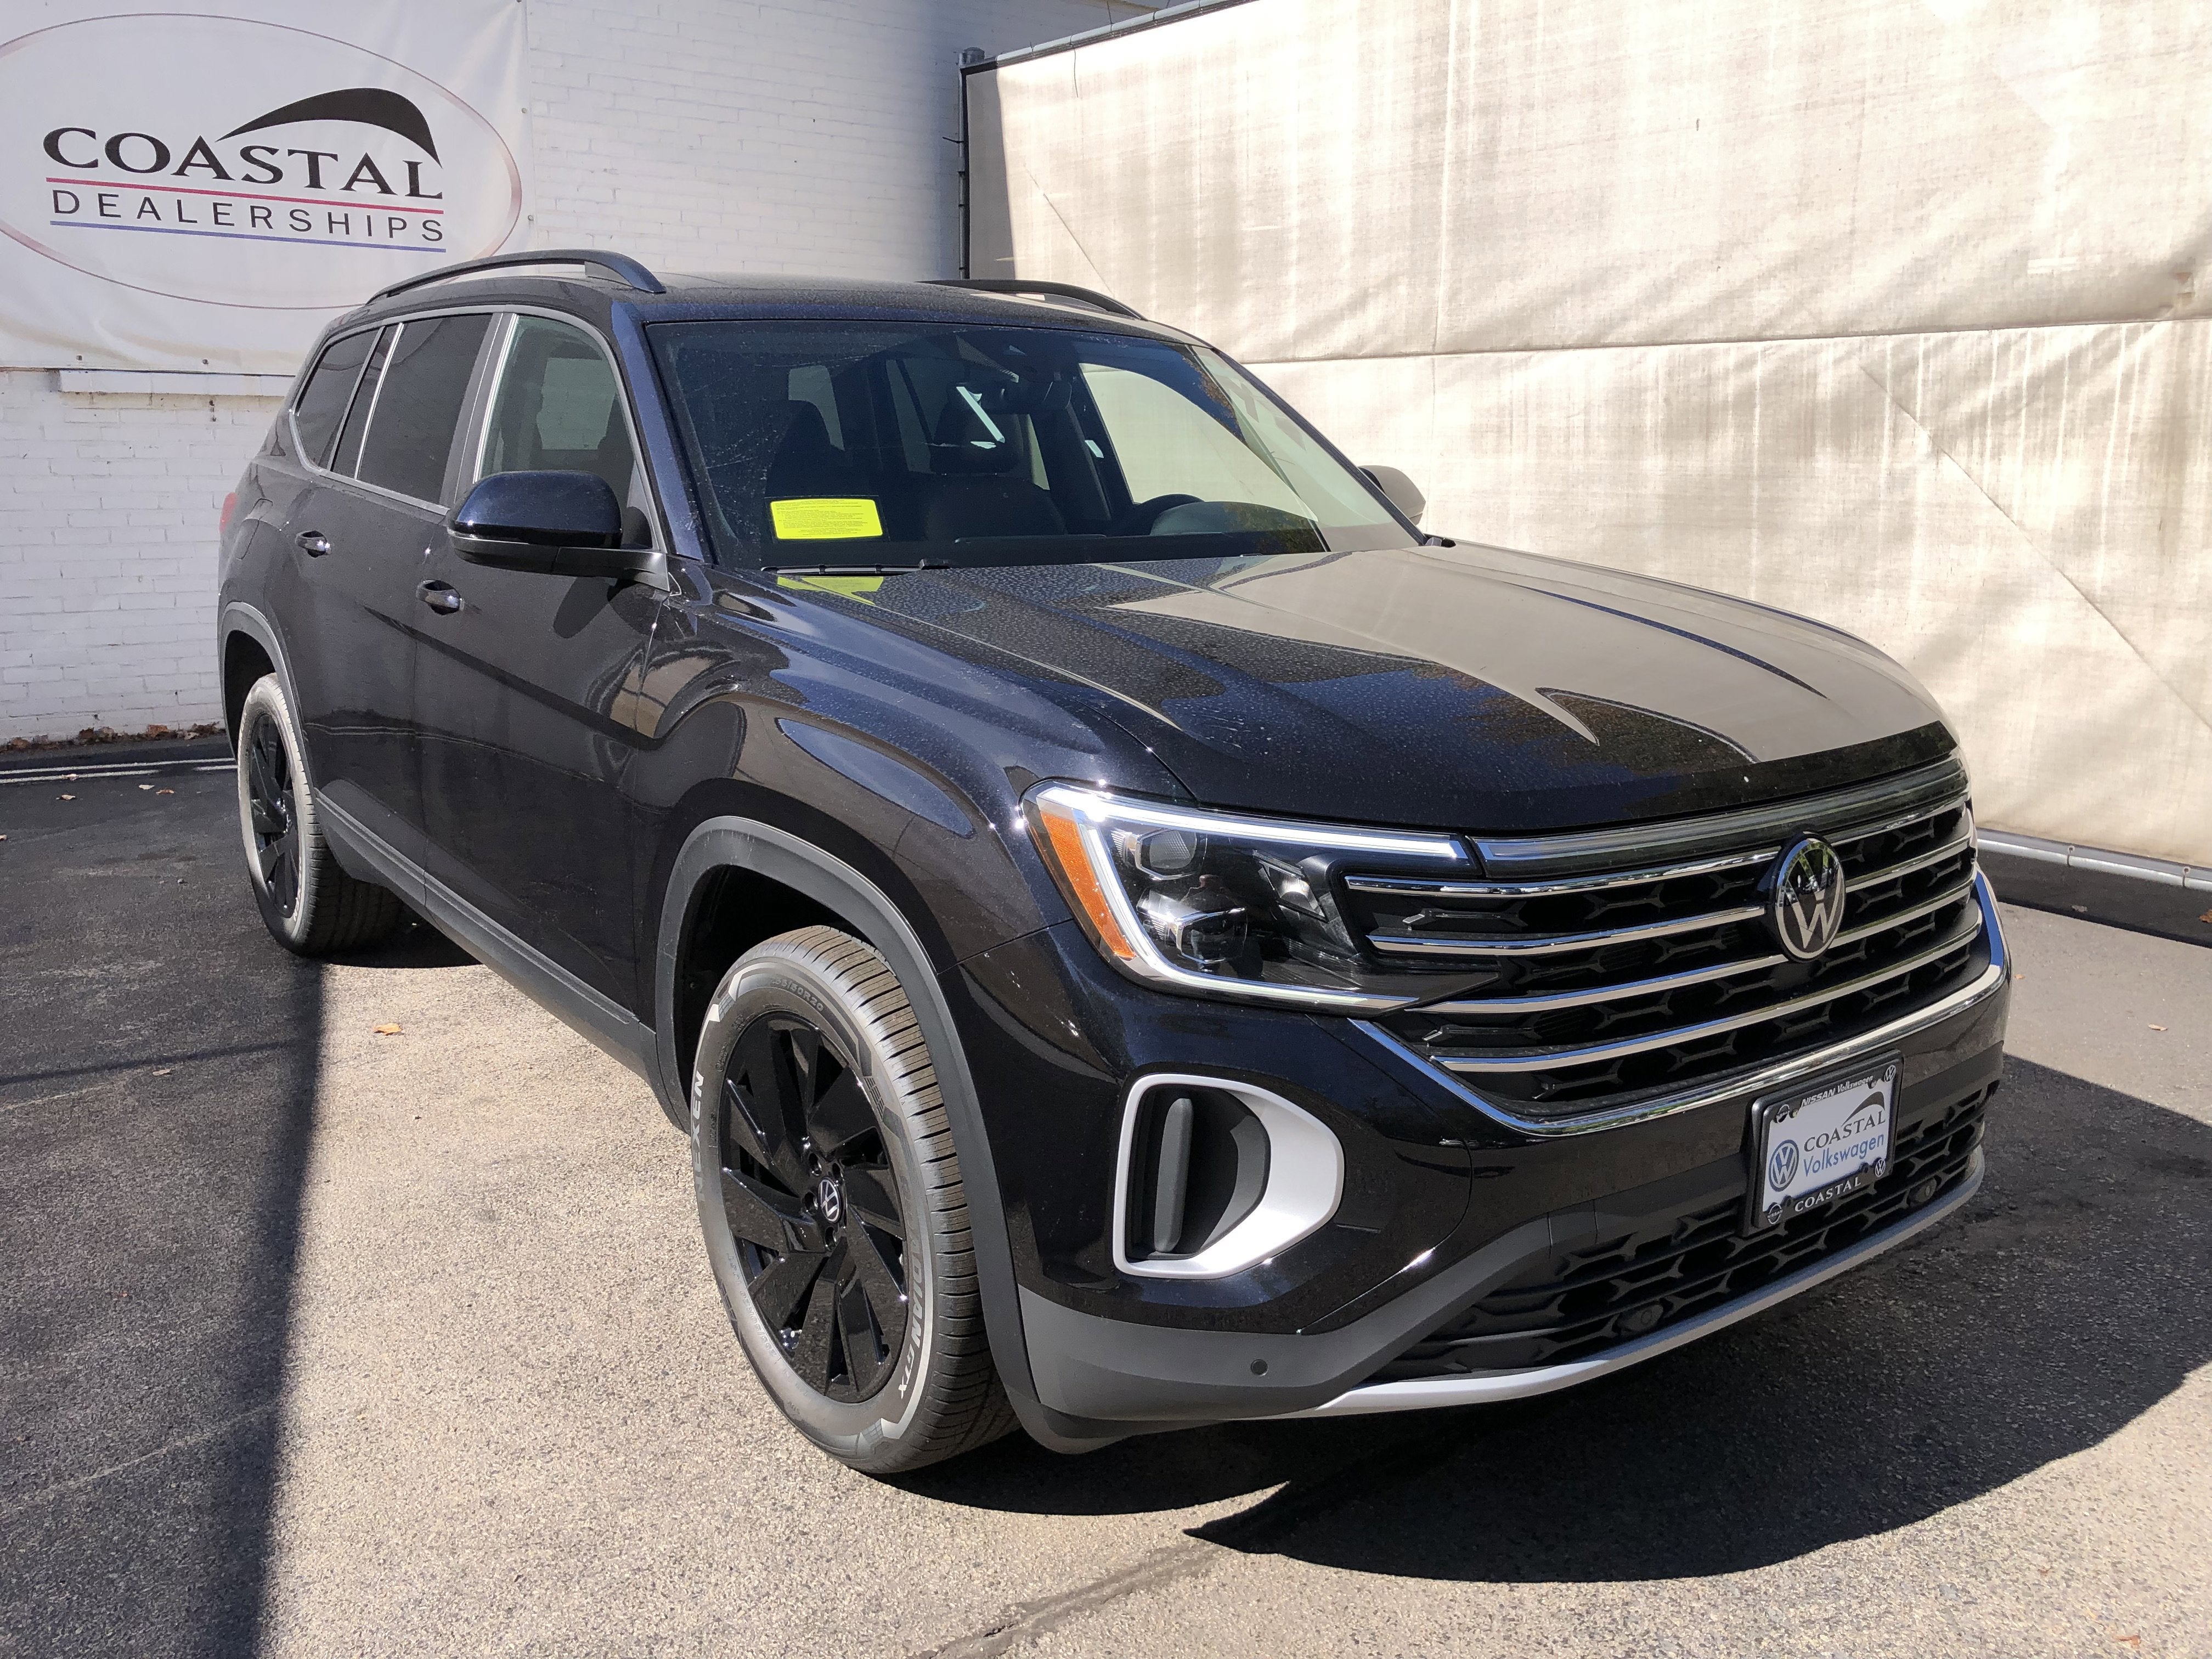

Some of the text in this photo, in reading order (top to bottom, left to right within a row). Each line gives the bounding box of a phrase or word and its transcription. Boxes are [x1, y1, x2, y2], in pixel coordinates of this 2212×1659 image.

[43, 126, 443, 200] COASTAL
[52, 190, 443, 241] DEALERSHIPS
[1801, 1075, 1873, 1108] NISSAN Volkswagen
[692, 1070, 705, 1202] NEXEN
[1803, 1110, 1886, 1152] COASTAL
[1803, 1134, 1884, 1177] Volkswagen
[1795, 1176, 1861, 1212] COASTAL
[898, 1343, 915, 1400] GTX
